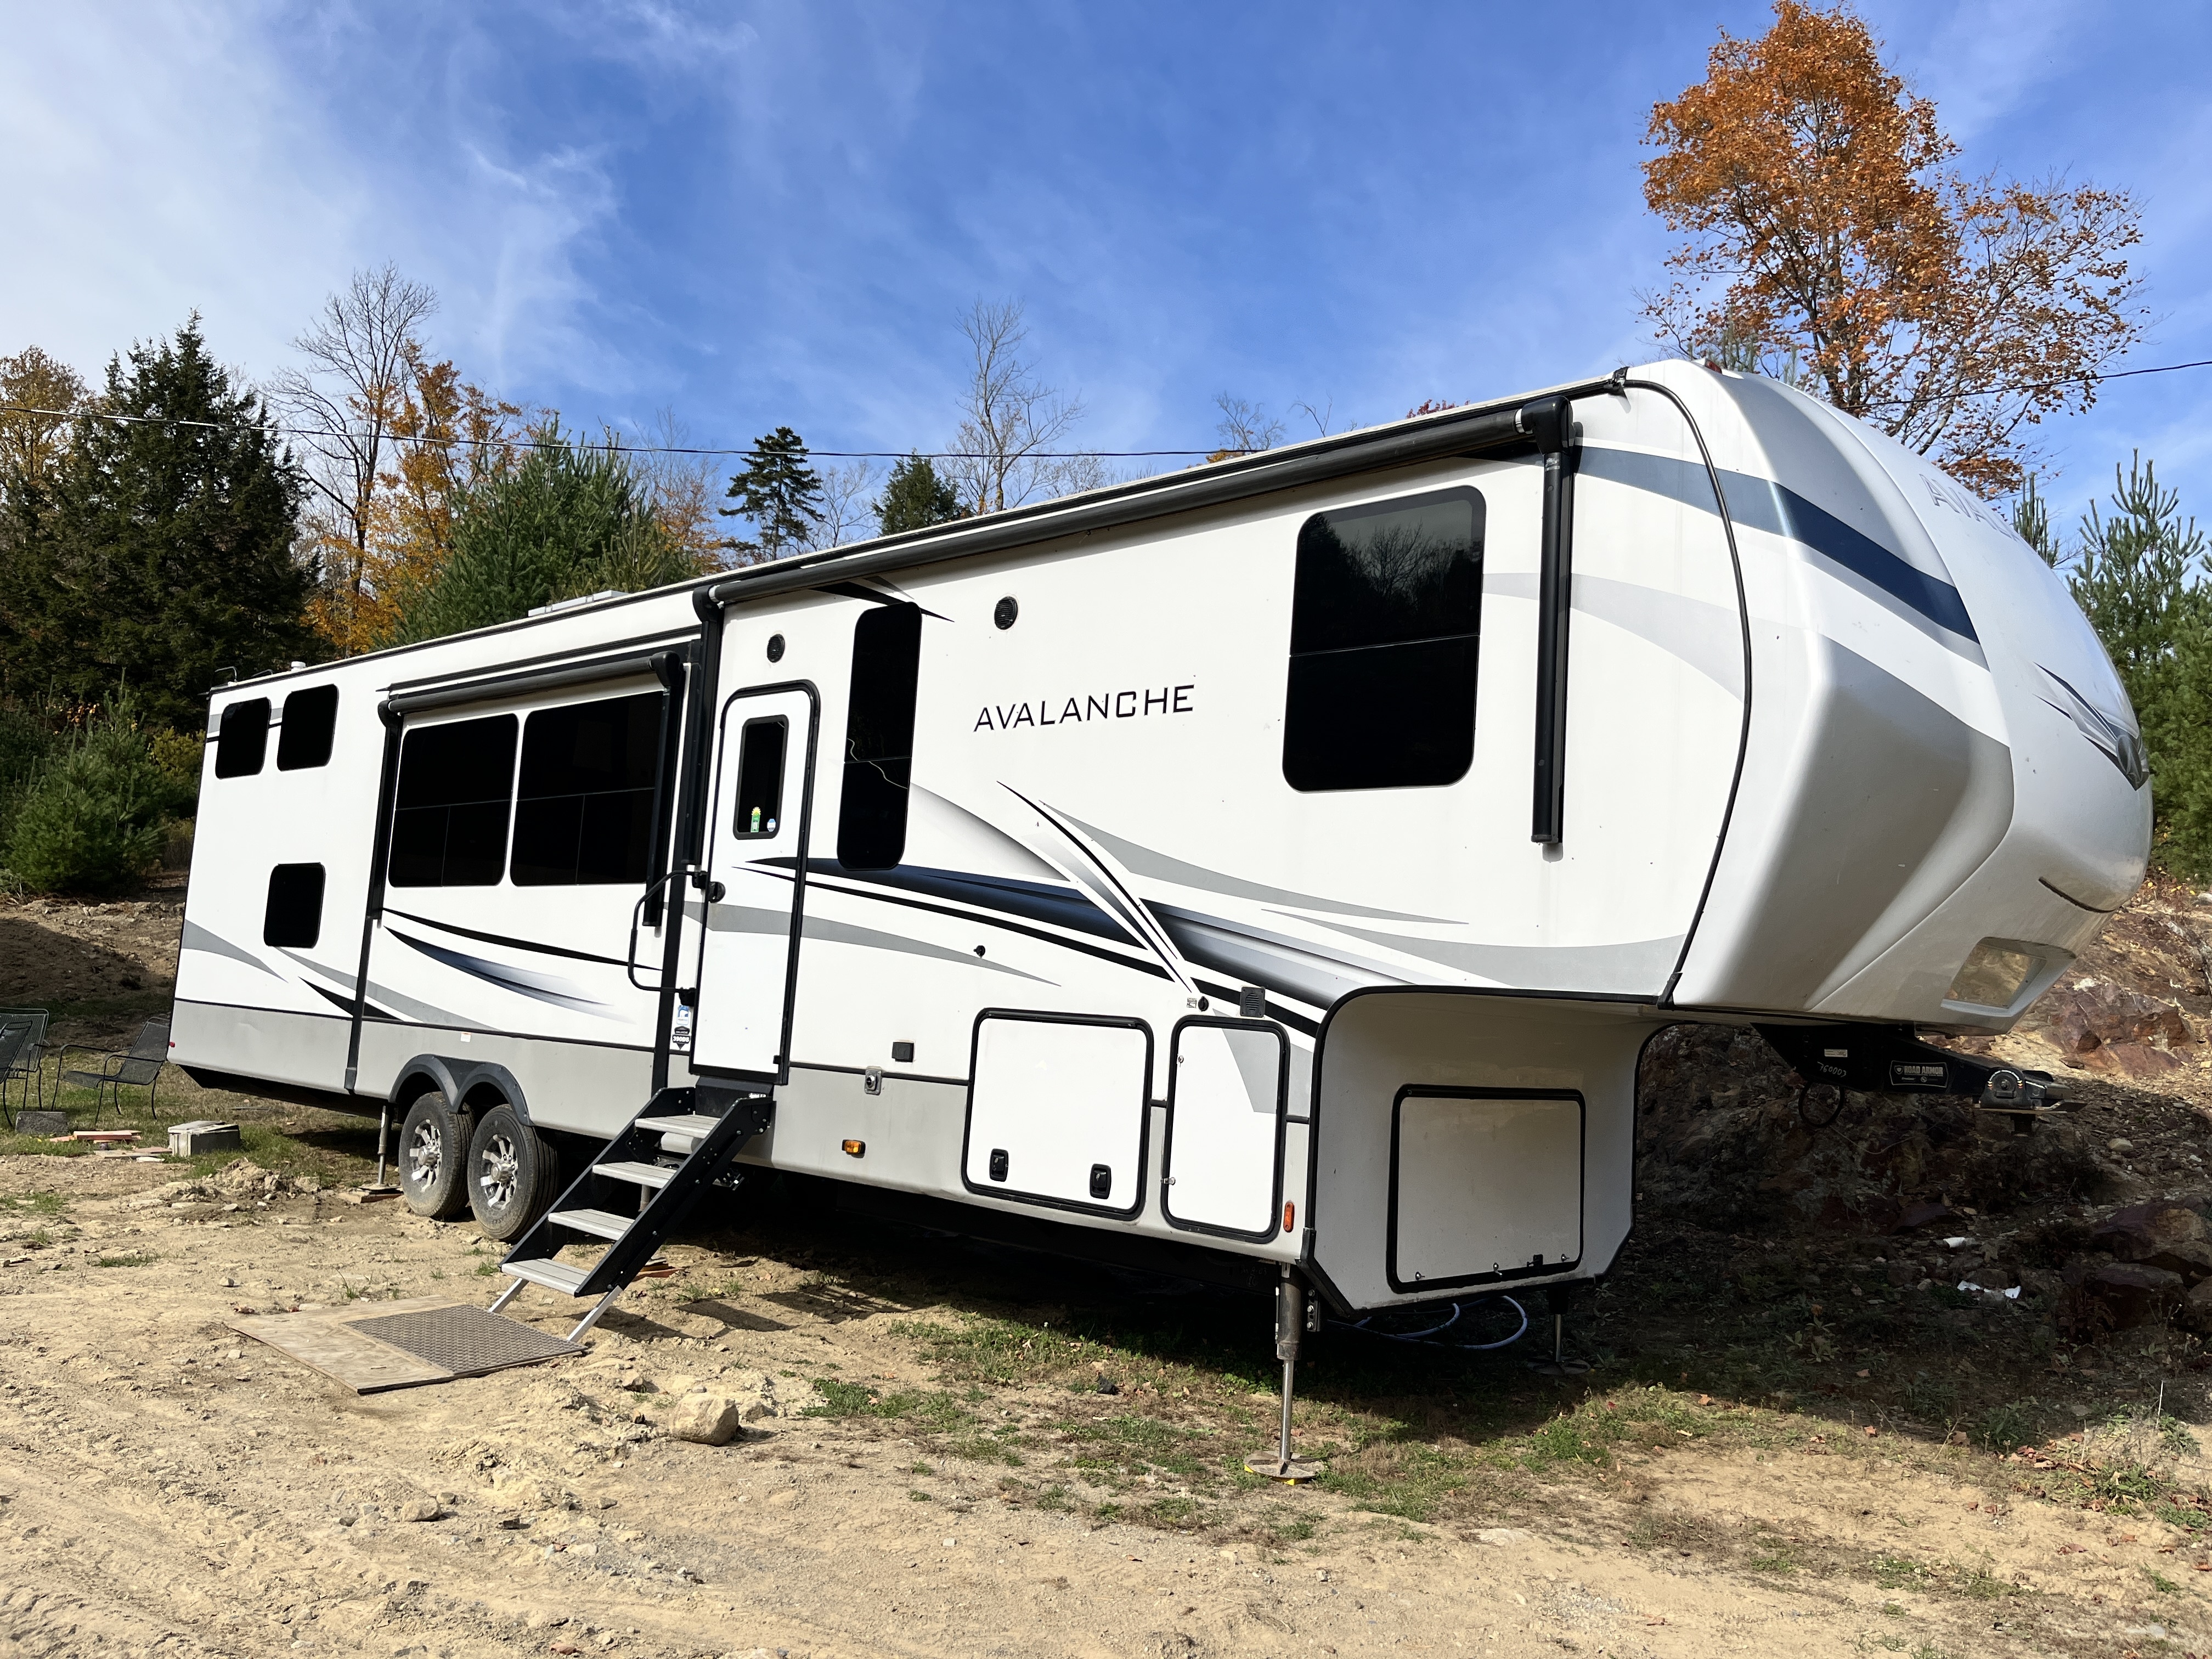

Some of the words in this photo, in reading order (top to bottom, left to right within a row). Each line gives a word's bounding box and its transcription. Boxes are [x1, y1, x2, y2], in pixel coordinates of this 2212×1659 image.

[973, 684, 1195, 732] AVALANCHE
[1904, 1065, 1920, 1074] ROAD
[1921, 1066, 1943, 1075] ARMOR
